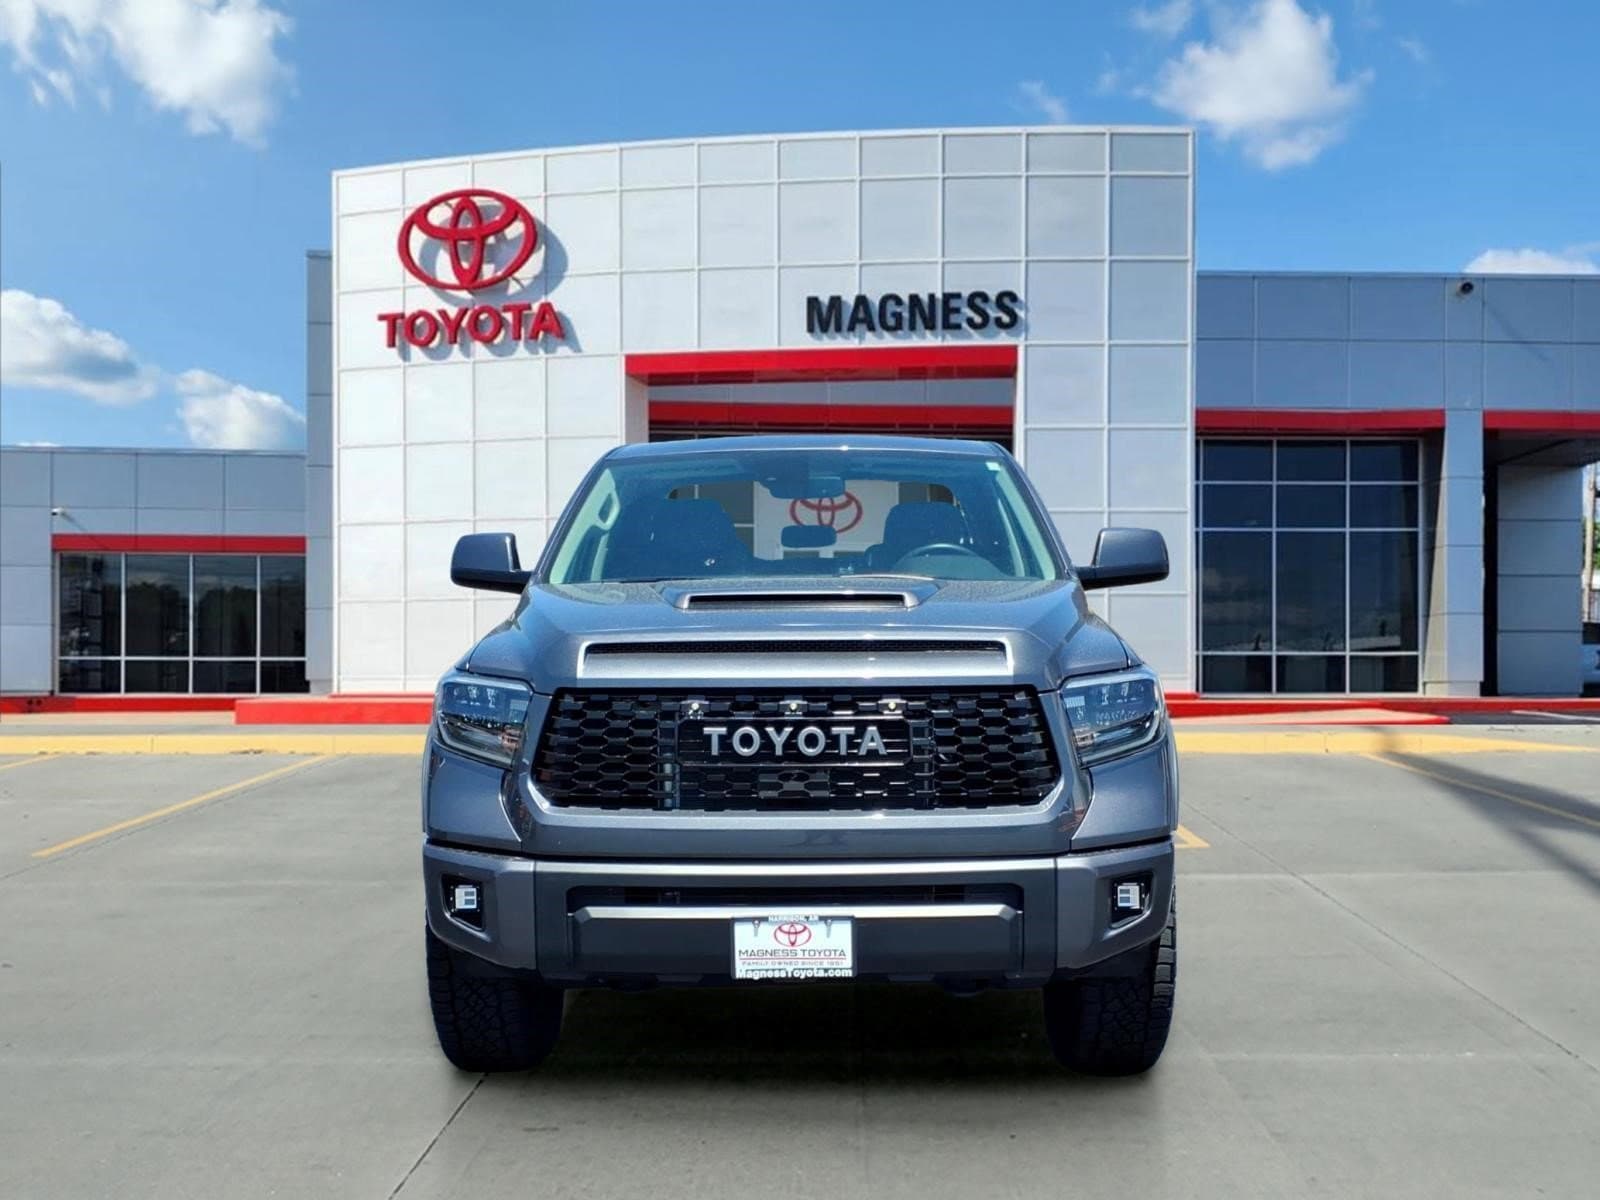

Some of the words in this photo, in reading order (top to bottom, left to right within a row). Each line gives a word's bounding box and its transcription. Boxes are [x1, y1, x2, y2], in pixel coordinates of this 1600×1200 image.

[377, 301, 565, 348] TOYOTA
[806, 291, 1018, 334] MAGNESS
[703, 726, 887, 756] TOYOTA
[738, 949, 797, 957] MAGNESS
[800, 949, 846, 957] TOYOTA
[735, 968, 853, 980] MagnessToyota.com
